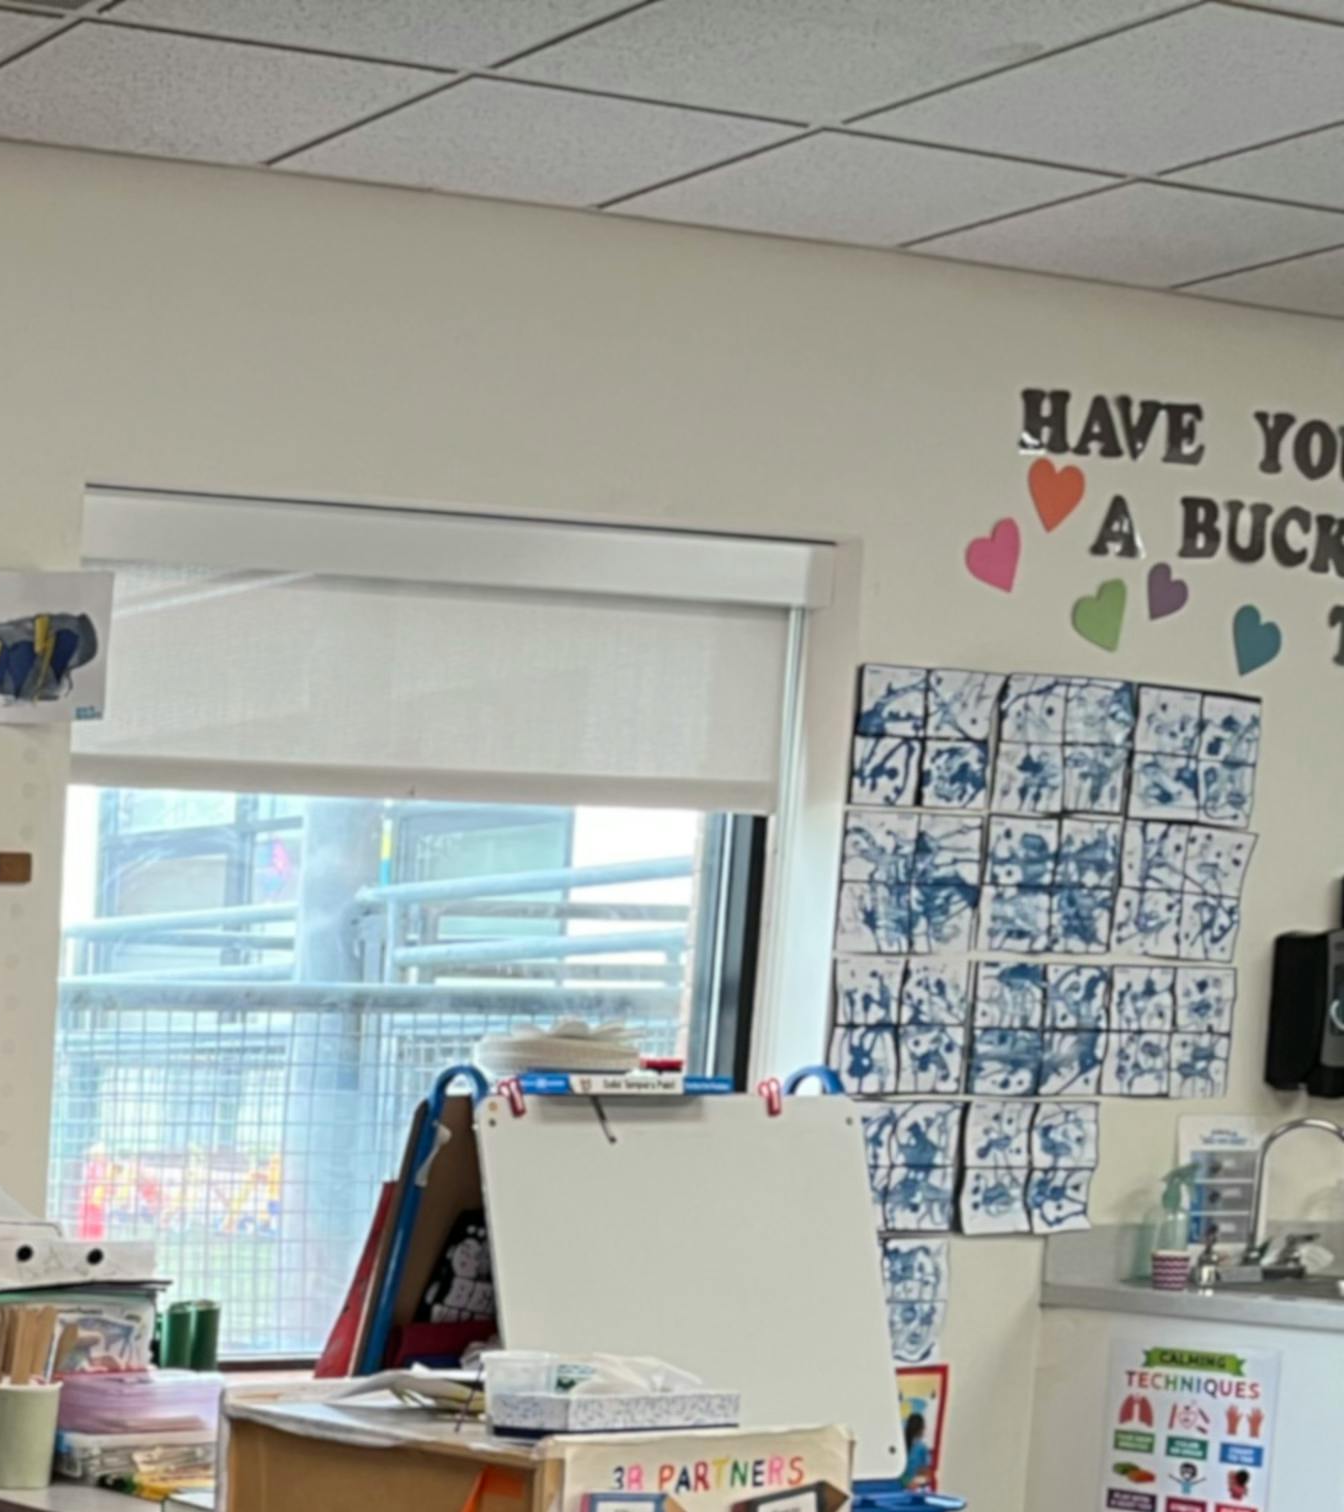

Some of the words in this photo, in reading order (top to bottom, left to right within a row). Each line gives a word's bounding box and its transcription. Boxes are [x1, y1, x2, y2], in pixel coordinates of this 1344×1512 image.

[1018, 388, 1205, 465] HAVE
[1254, 410, 1344, 481] YO
[1089, 495, 1139, 558] A
[1159, 1348, 1227, 1370] CALMING
[1125, 1370, 1261, 1400] TECHNIQUES
[658, 1456, 806, 1494] PARTNERS
